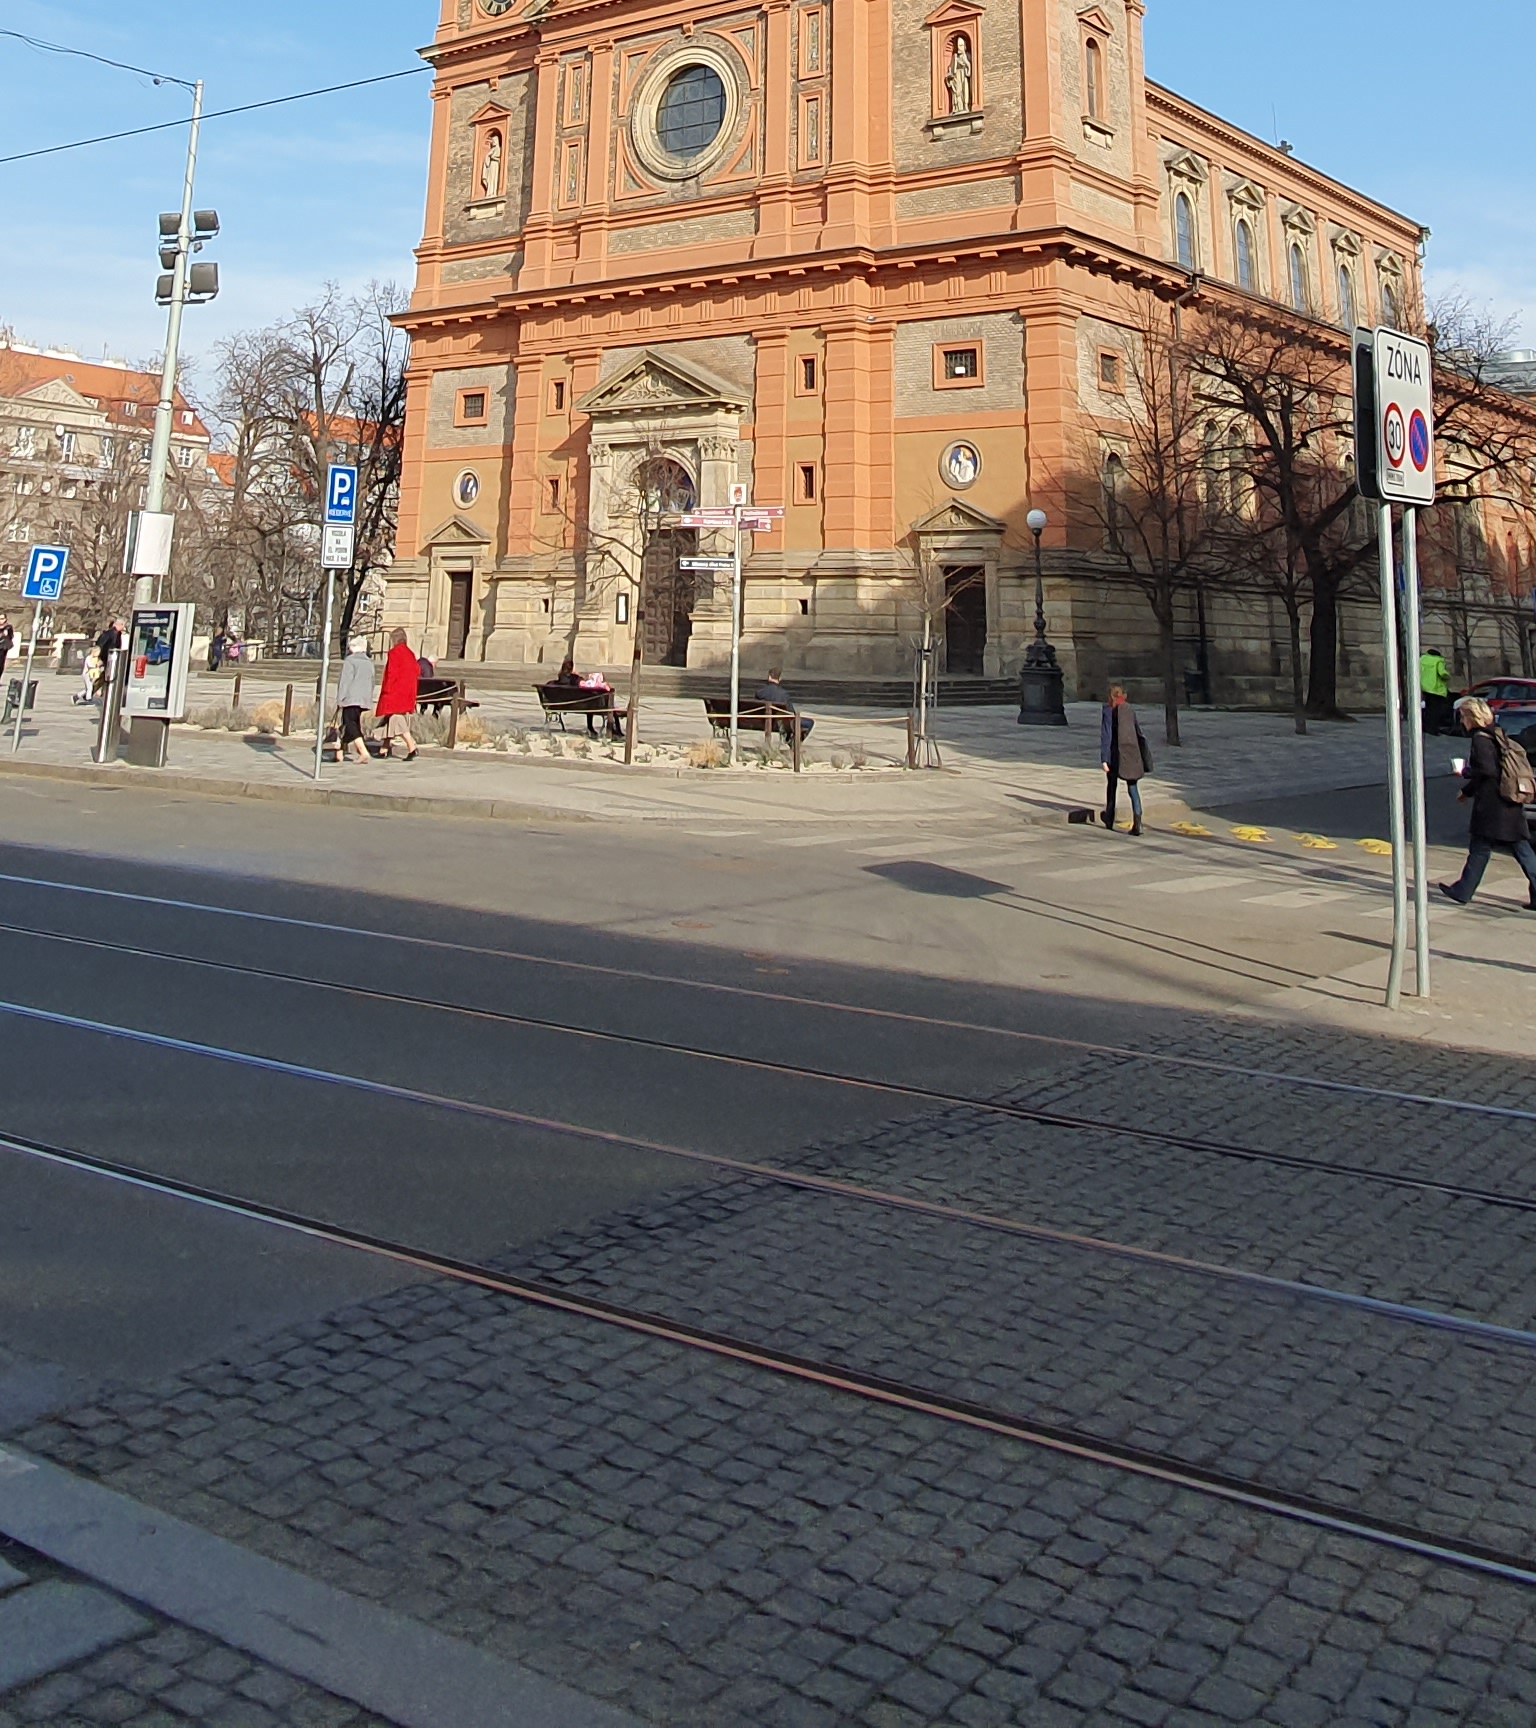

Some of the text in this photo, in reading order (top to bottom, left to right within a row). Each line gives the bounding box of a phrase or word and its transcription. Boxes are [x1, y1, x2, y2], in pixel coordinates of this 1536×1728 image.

[1387, 342, 1422, 387] ZÓNA
[1388, 420, 1402, 450] 30
[33, 552, 59, 582] P
